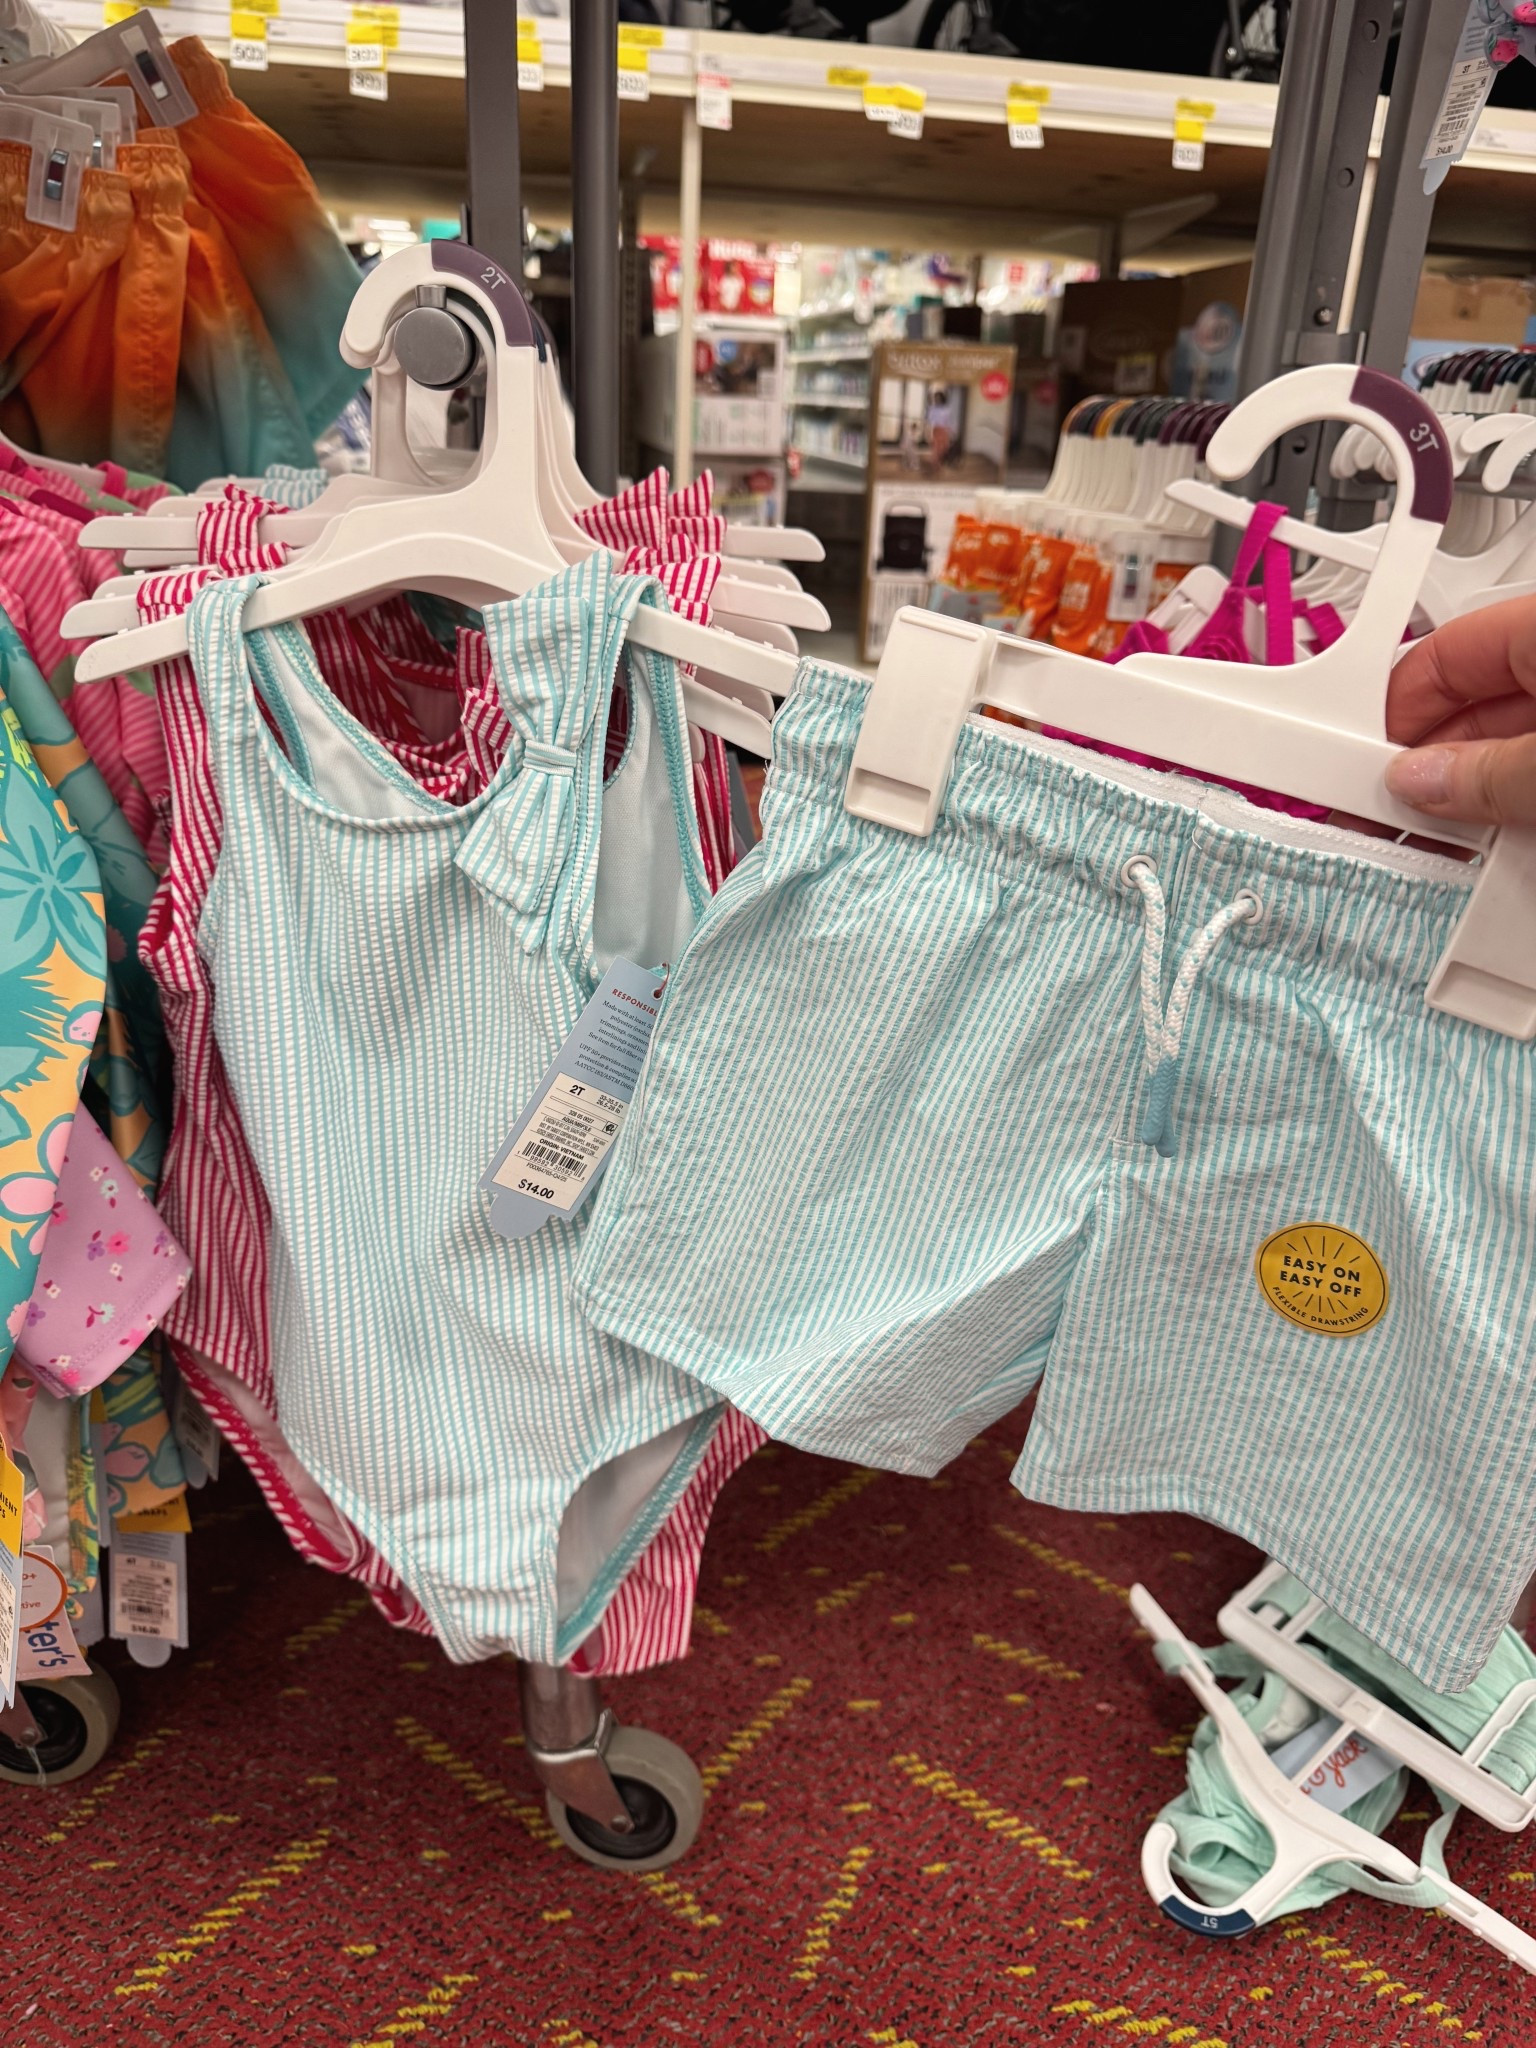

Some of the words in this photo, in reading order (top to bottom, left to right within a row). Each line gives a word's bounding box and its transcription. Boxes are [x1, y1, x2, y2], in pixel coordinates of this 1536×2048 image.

[480, 266, 506, 290] 2T
[1409, 422, 1440, 452] 3T
[603, 1001, 618, 1012] Made
[612, 989, 659, 1016] RESPONSIBL
[569, 1084, 586, 1097] 2T
[539, 1139, 560, 1150] ORIGIN:
[560, 1147, 584, 1160] VIETNAM
[518, 1179, 555, 1199] $14.00
[1284, 1256, 1327, 1273] EASY
[1334, 1267, 1360, 1282] ON
[1280, 1271, 1323, 1288] EASY
[1330, 1282, 1362, 1297] OFF
[1273, 1286, 1307, 1318] FLEXIBLE
[1310, 1307, 1369, 1326] DRAWSTRING
[1200, 1916, 1219, 1929] 5T
